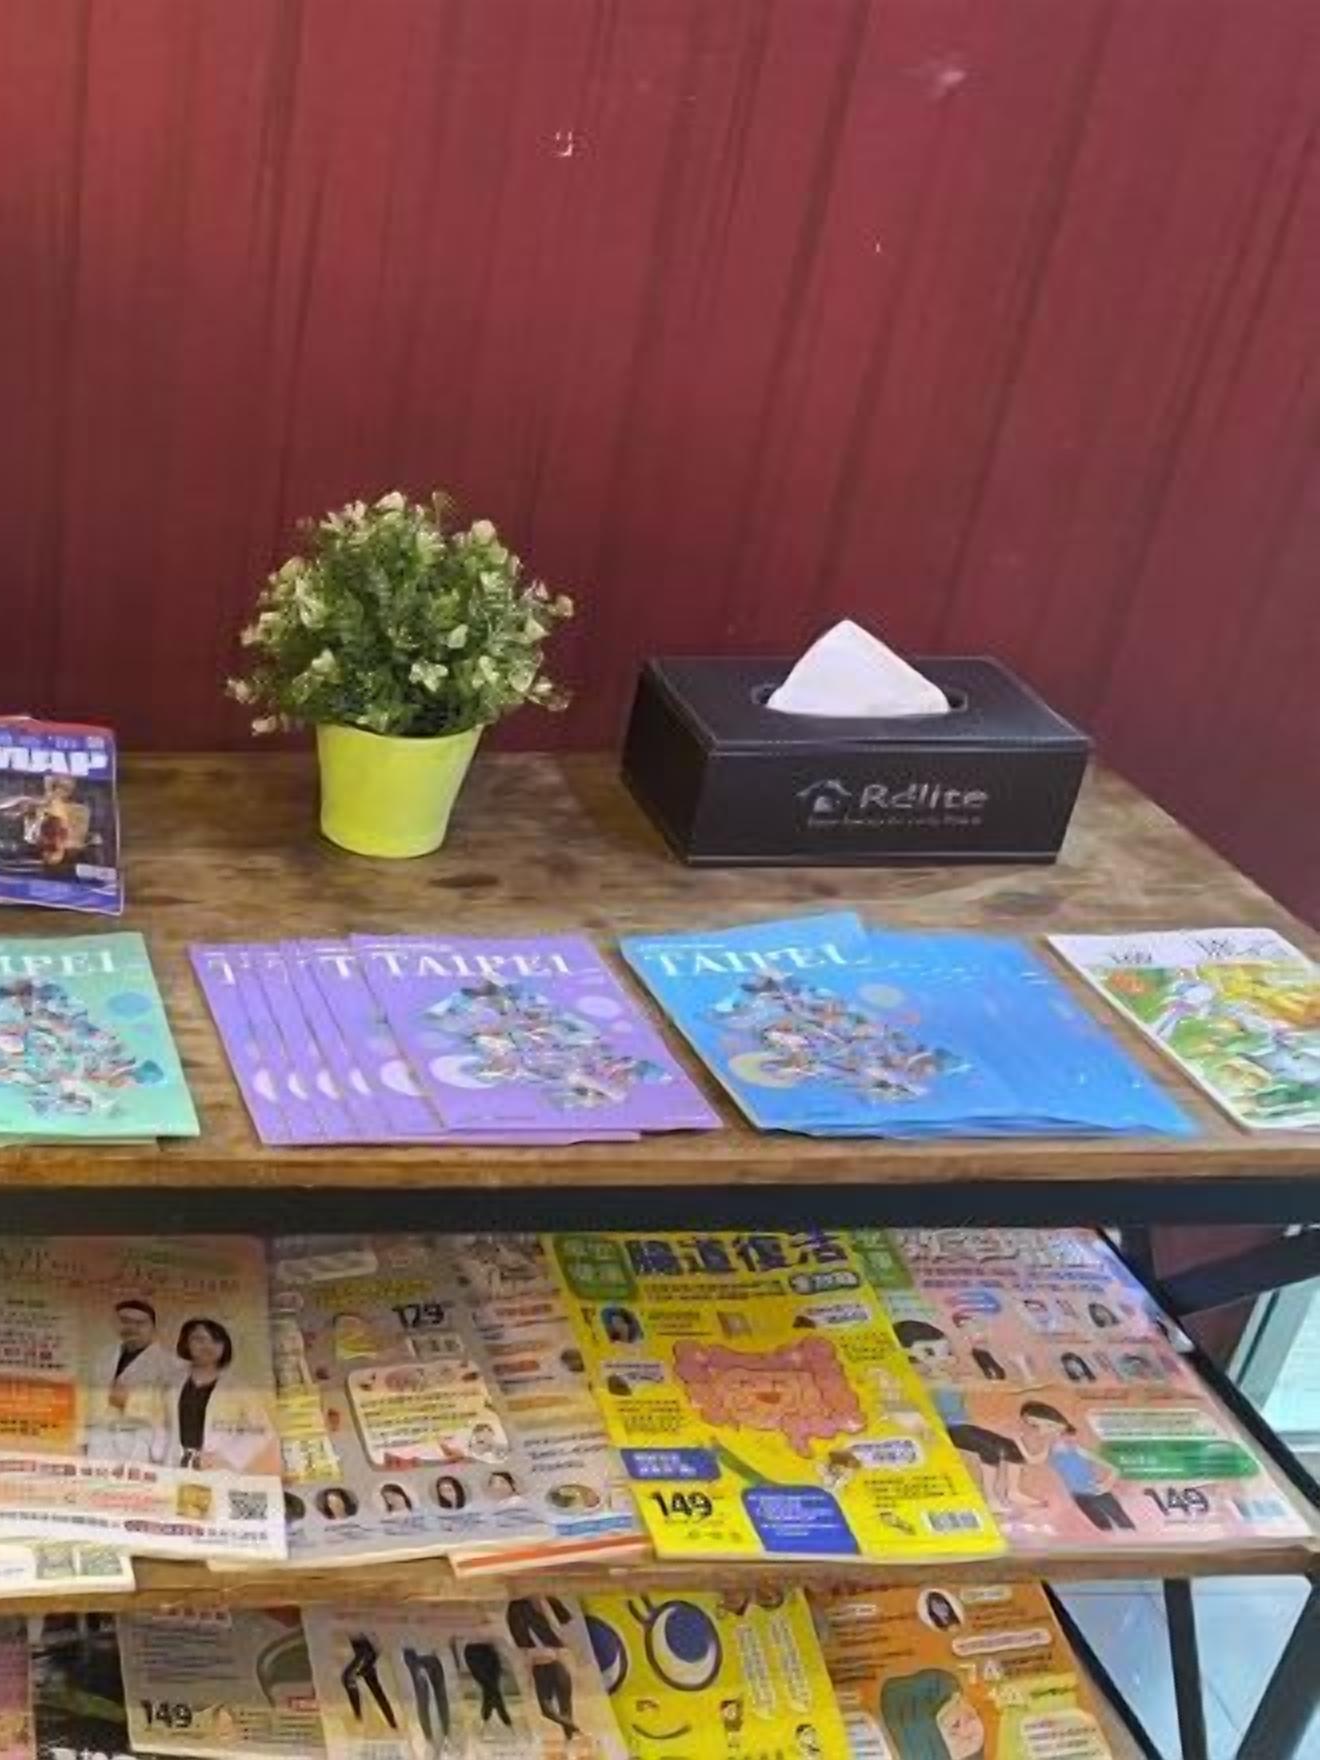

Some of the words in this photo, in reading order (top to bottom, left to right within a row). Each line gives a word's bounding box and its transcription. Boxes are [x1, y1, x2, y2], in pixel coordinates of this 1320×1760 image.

[371, 952, 573, 976] TAIPEI
[644, 943, 847, 977] TAIPEI
[651, 1491, 713, 1521] 149
[1143, 1486, 1209, 1516] 149
[141, 1699, 193, 1728] 149
